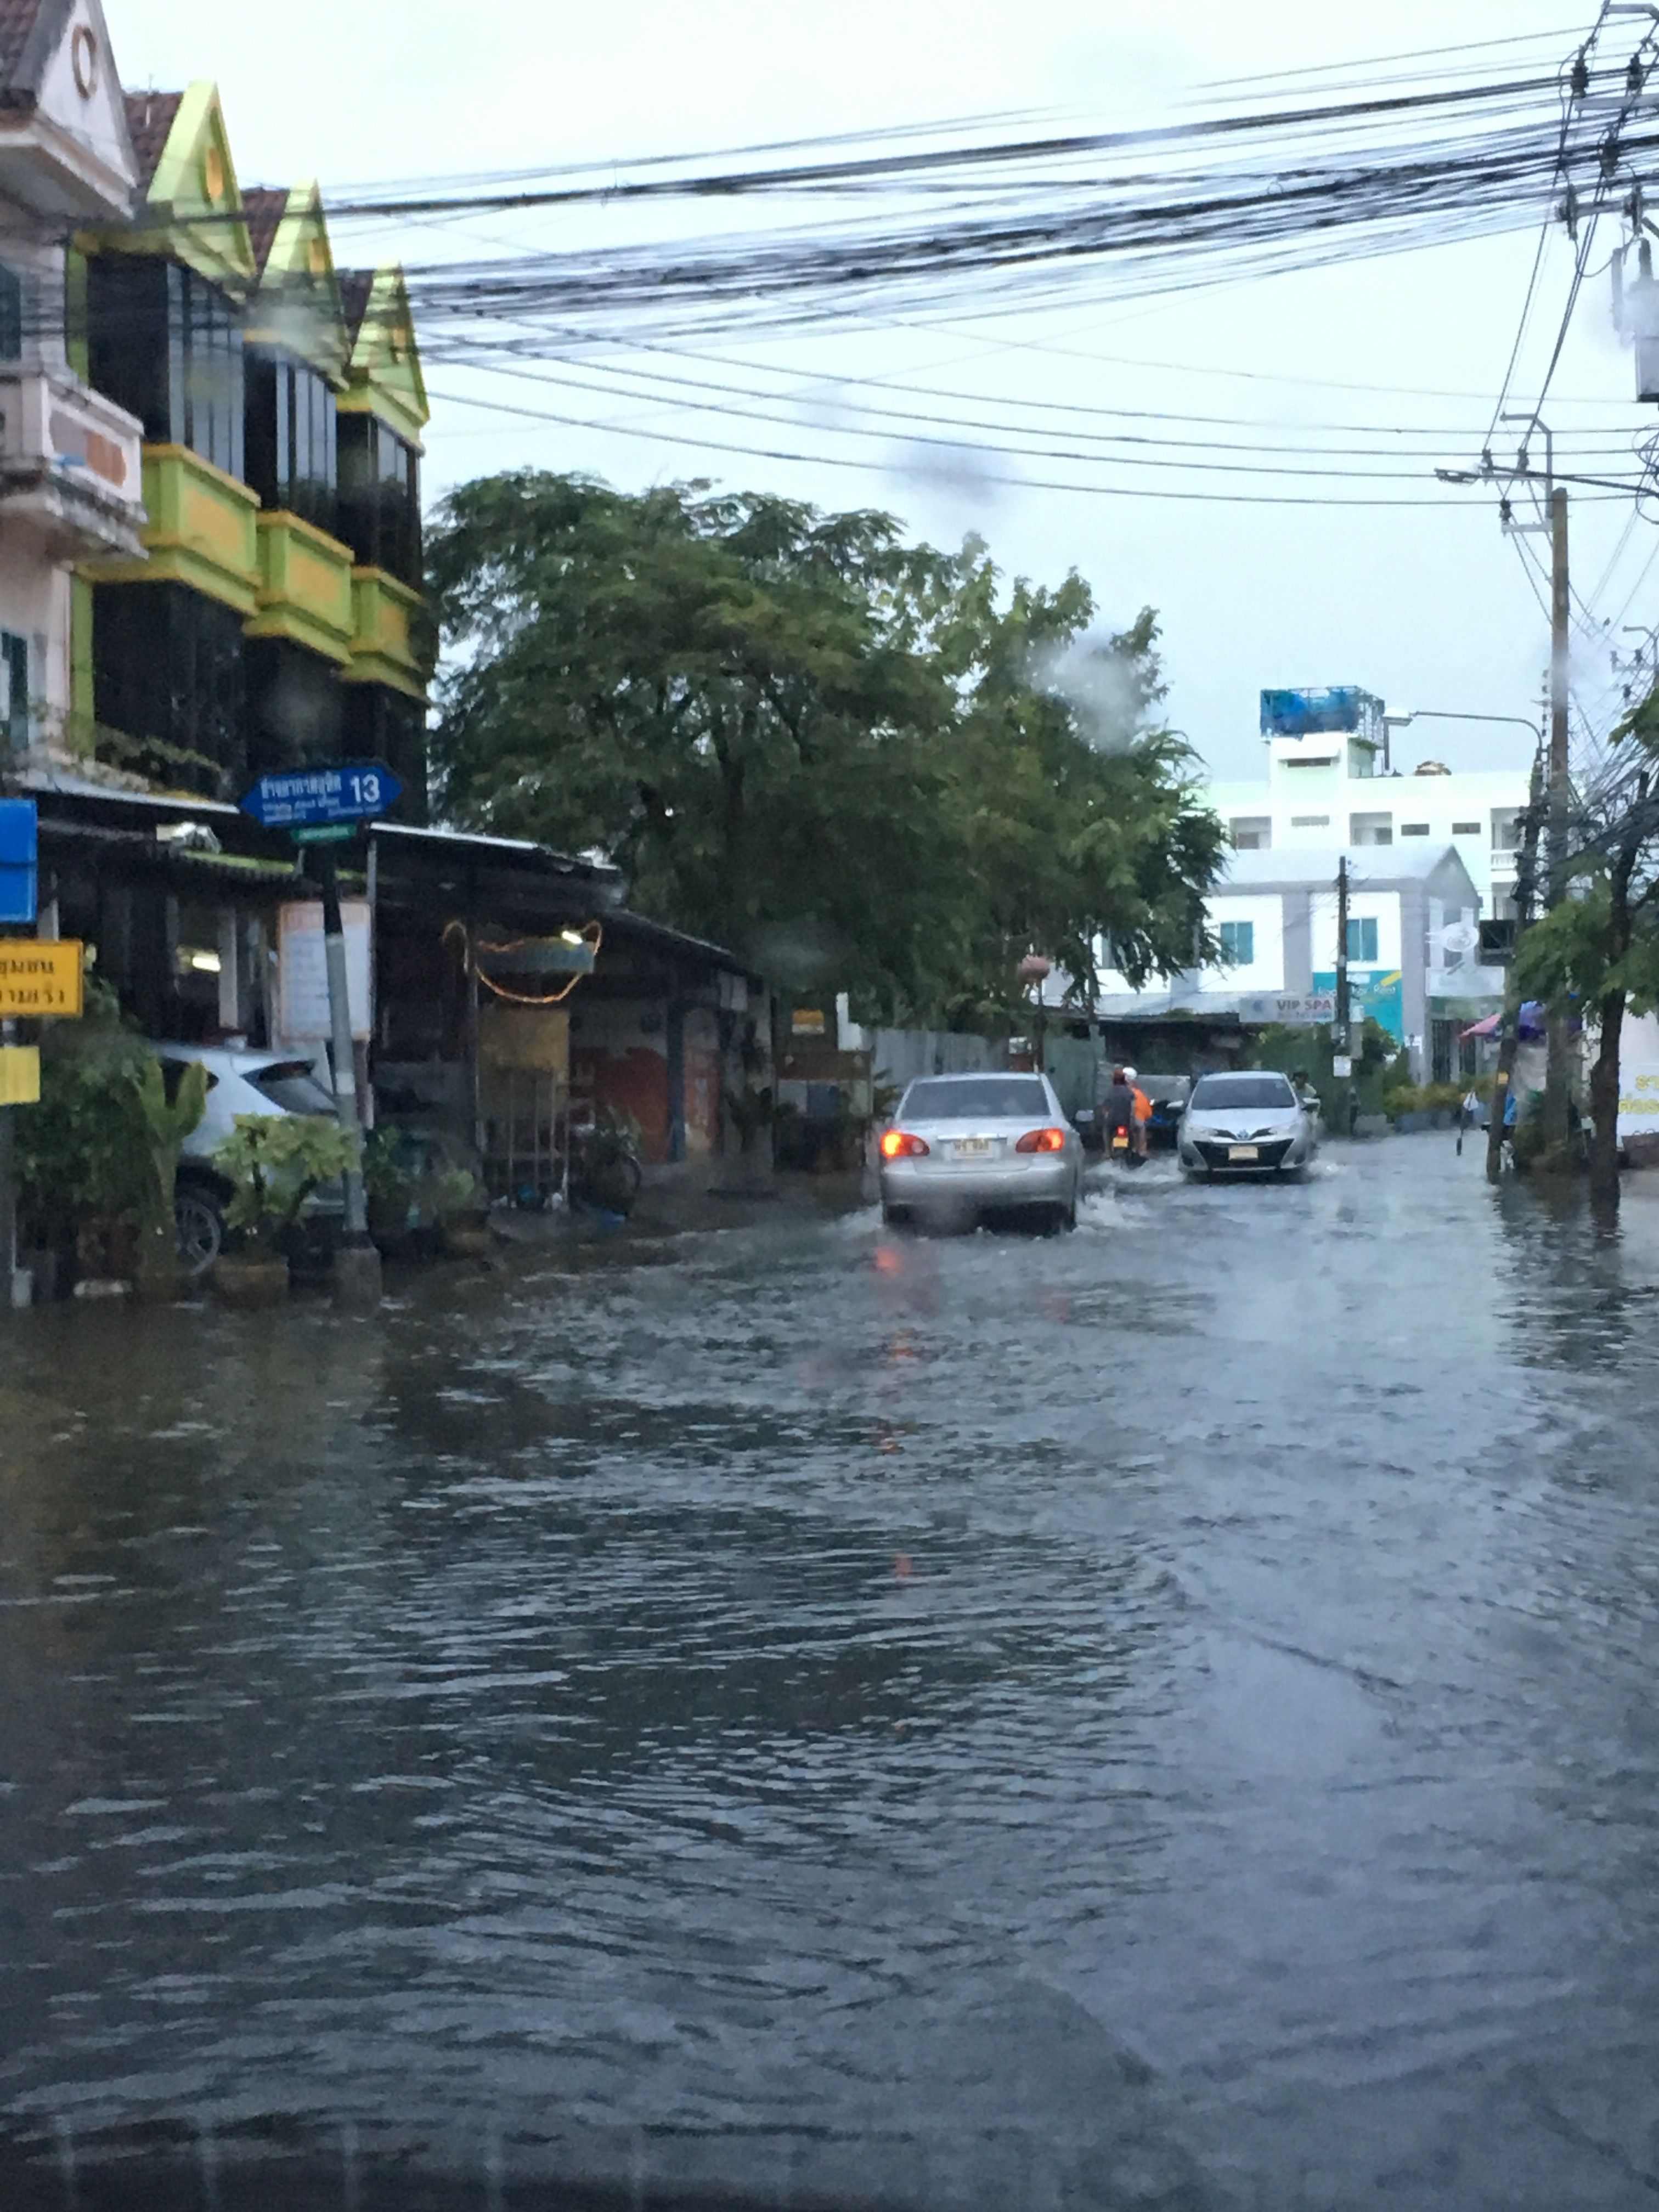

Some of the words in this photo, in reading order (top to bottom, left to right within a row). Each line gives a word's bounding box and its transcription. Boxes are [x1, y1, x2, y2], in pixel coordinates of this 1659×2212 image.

[350, 774, 380, 803] 13
[1277, 1000, 1300, 1011] VIP
[1305, 1000, 1331, 1011] SPA
